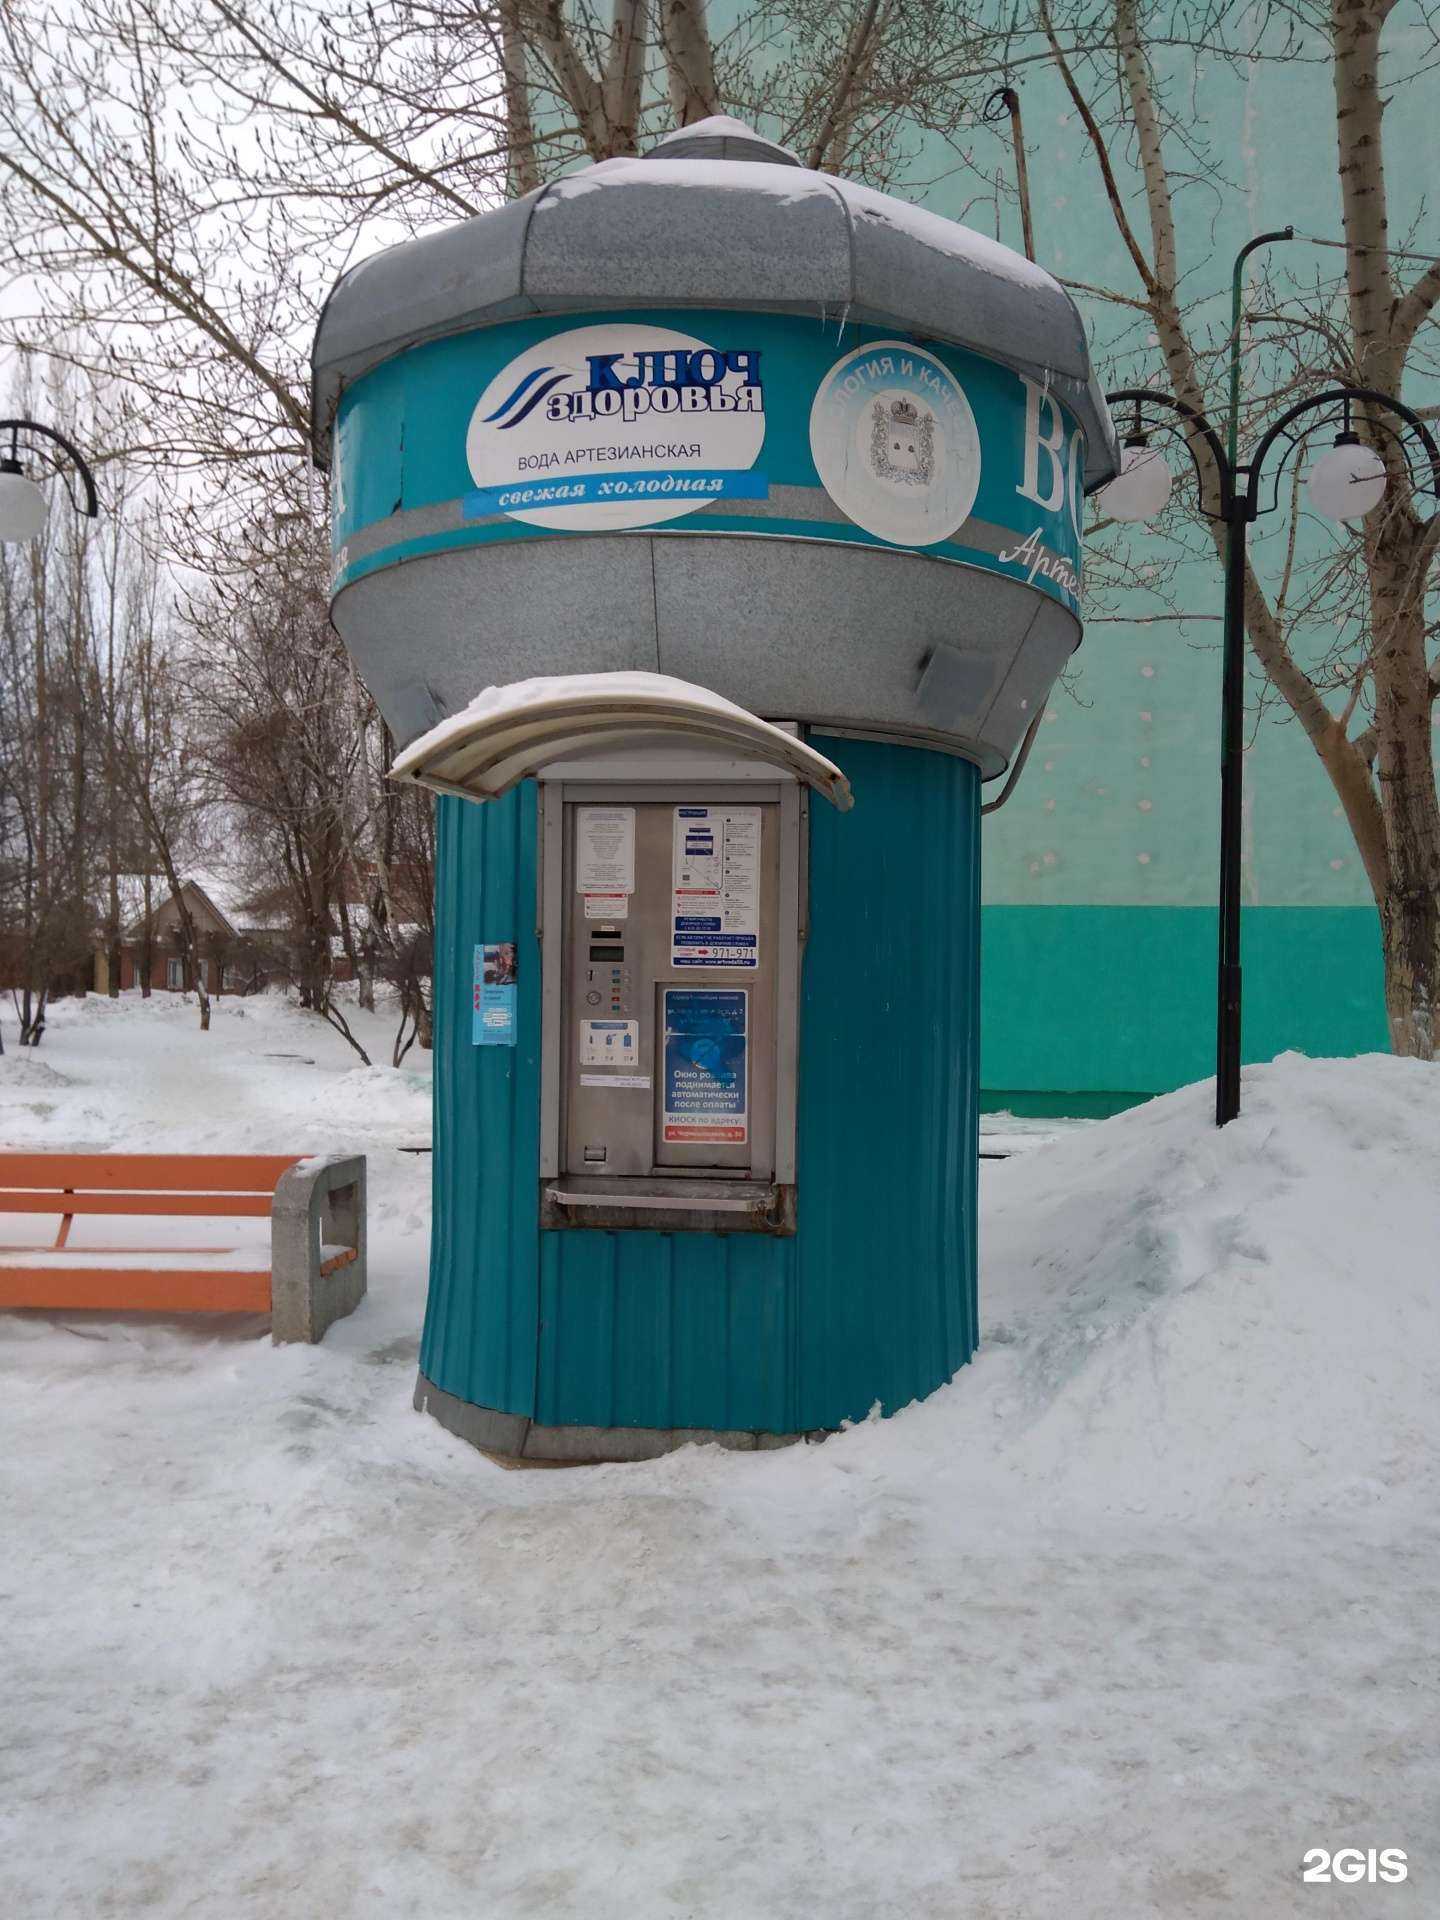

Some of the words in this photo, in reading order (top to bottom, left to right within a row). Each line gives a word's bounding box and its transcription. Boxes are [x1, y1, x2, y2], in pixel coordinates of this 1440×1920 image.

[585, 350, 762, 388] КЛЮЧ
[900, 358, 913, 377] И
[518, 454, 560, 471] ВОДА
[564, 443, 701, 464] АРТЕЗИАНСКАЯ
[498, 481, 586, 506] свежая
[597, 475, 724, 496] холодная
[712, 948, 754, 958] 971-971
[673, 1070, 697, 1079] Окно
[671, 1091, 740, 1099] автоматически
[674, 1101, 703, 1109] после
